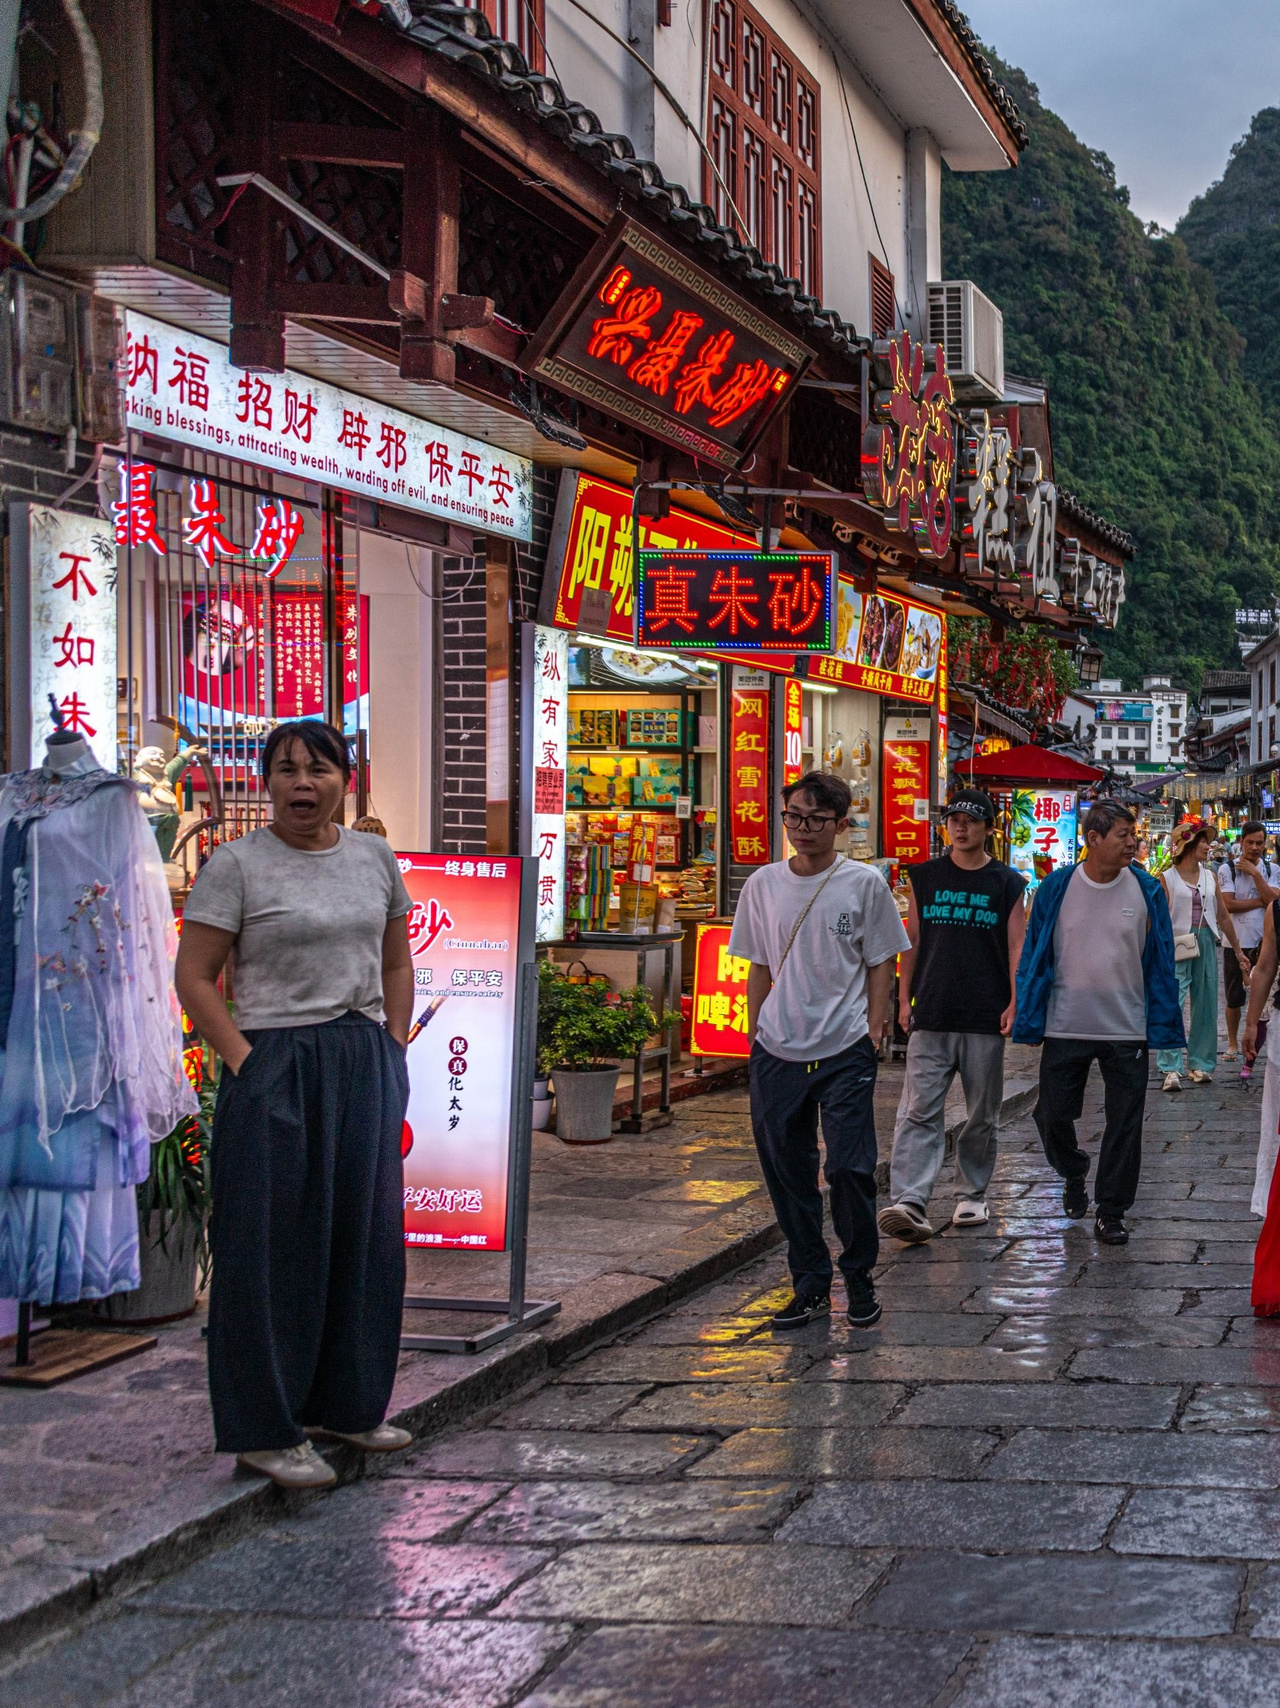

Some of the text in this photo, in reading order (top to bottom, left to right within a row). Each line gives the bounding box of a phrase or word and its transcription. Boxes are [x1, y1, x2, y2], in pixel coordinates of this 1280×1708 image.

[167, 407, 235, 447] blessings,
[238, 433, 297, 466] attracting
[301, 453, 342, 478] wealth,
[345, 467, 388, 493] warding
[391, 479, 406, 495] off
[408, 485, 429, 504] evil,
[431, 493, 449, 508] and
[450, 500, 489, 523] ensuring
[490, 511, 515, 528] peace
[235, 371, 318, 443] 招财
[337, 409, 407, 473] 辟邪
[425, 440, 514, 508] 保平安
[644, 565, 824, 636] 真朱砂
[735, 697, 766, 857] 网红雪花酥
[892, 745, 921, 858] 桂花飘香入口即
[1034, 796, 1062, 864] 椰子
[922, 904, 999, 926] LOVE MY DOG
[934, 890, 990, 907] LOVE ME
[443, 939, 509, 952] (Cinnabar)
[451, 969, 503, 986] 保平安
[478, 990, 504, 999] safety
